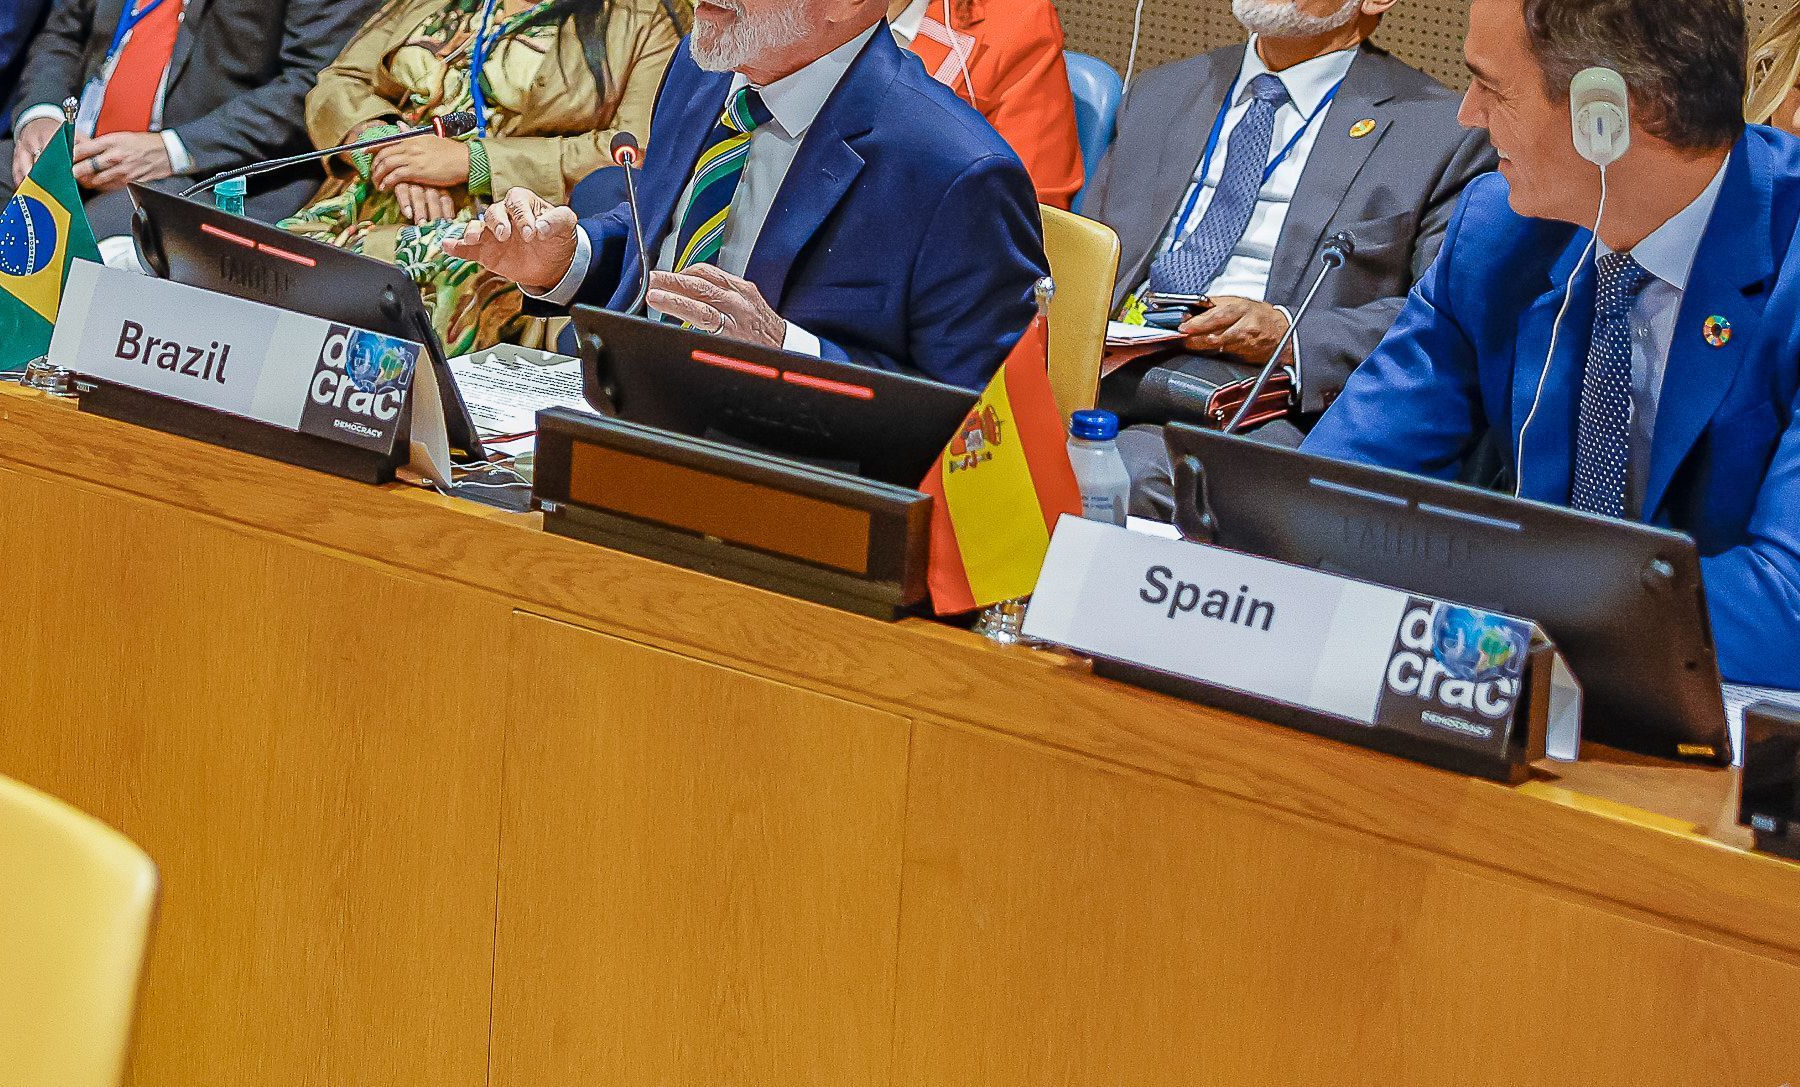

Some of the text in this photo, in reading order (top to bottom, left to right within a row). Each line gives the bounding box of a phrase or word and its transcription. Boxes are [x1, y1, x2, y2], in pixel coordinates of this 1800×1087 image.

[115, 319, 231, 385] Brazil
[312, 369, 406, 420] crac
[333, 419, 383, 438] DEMOCRACY
[1139, 565, 1275, 631] Spain
